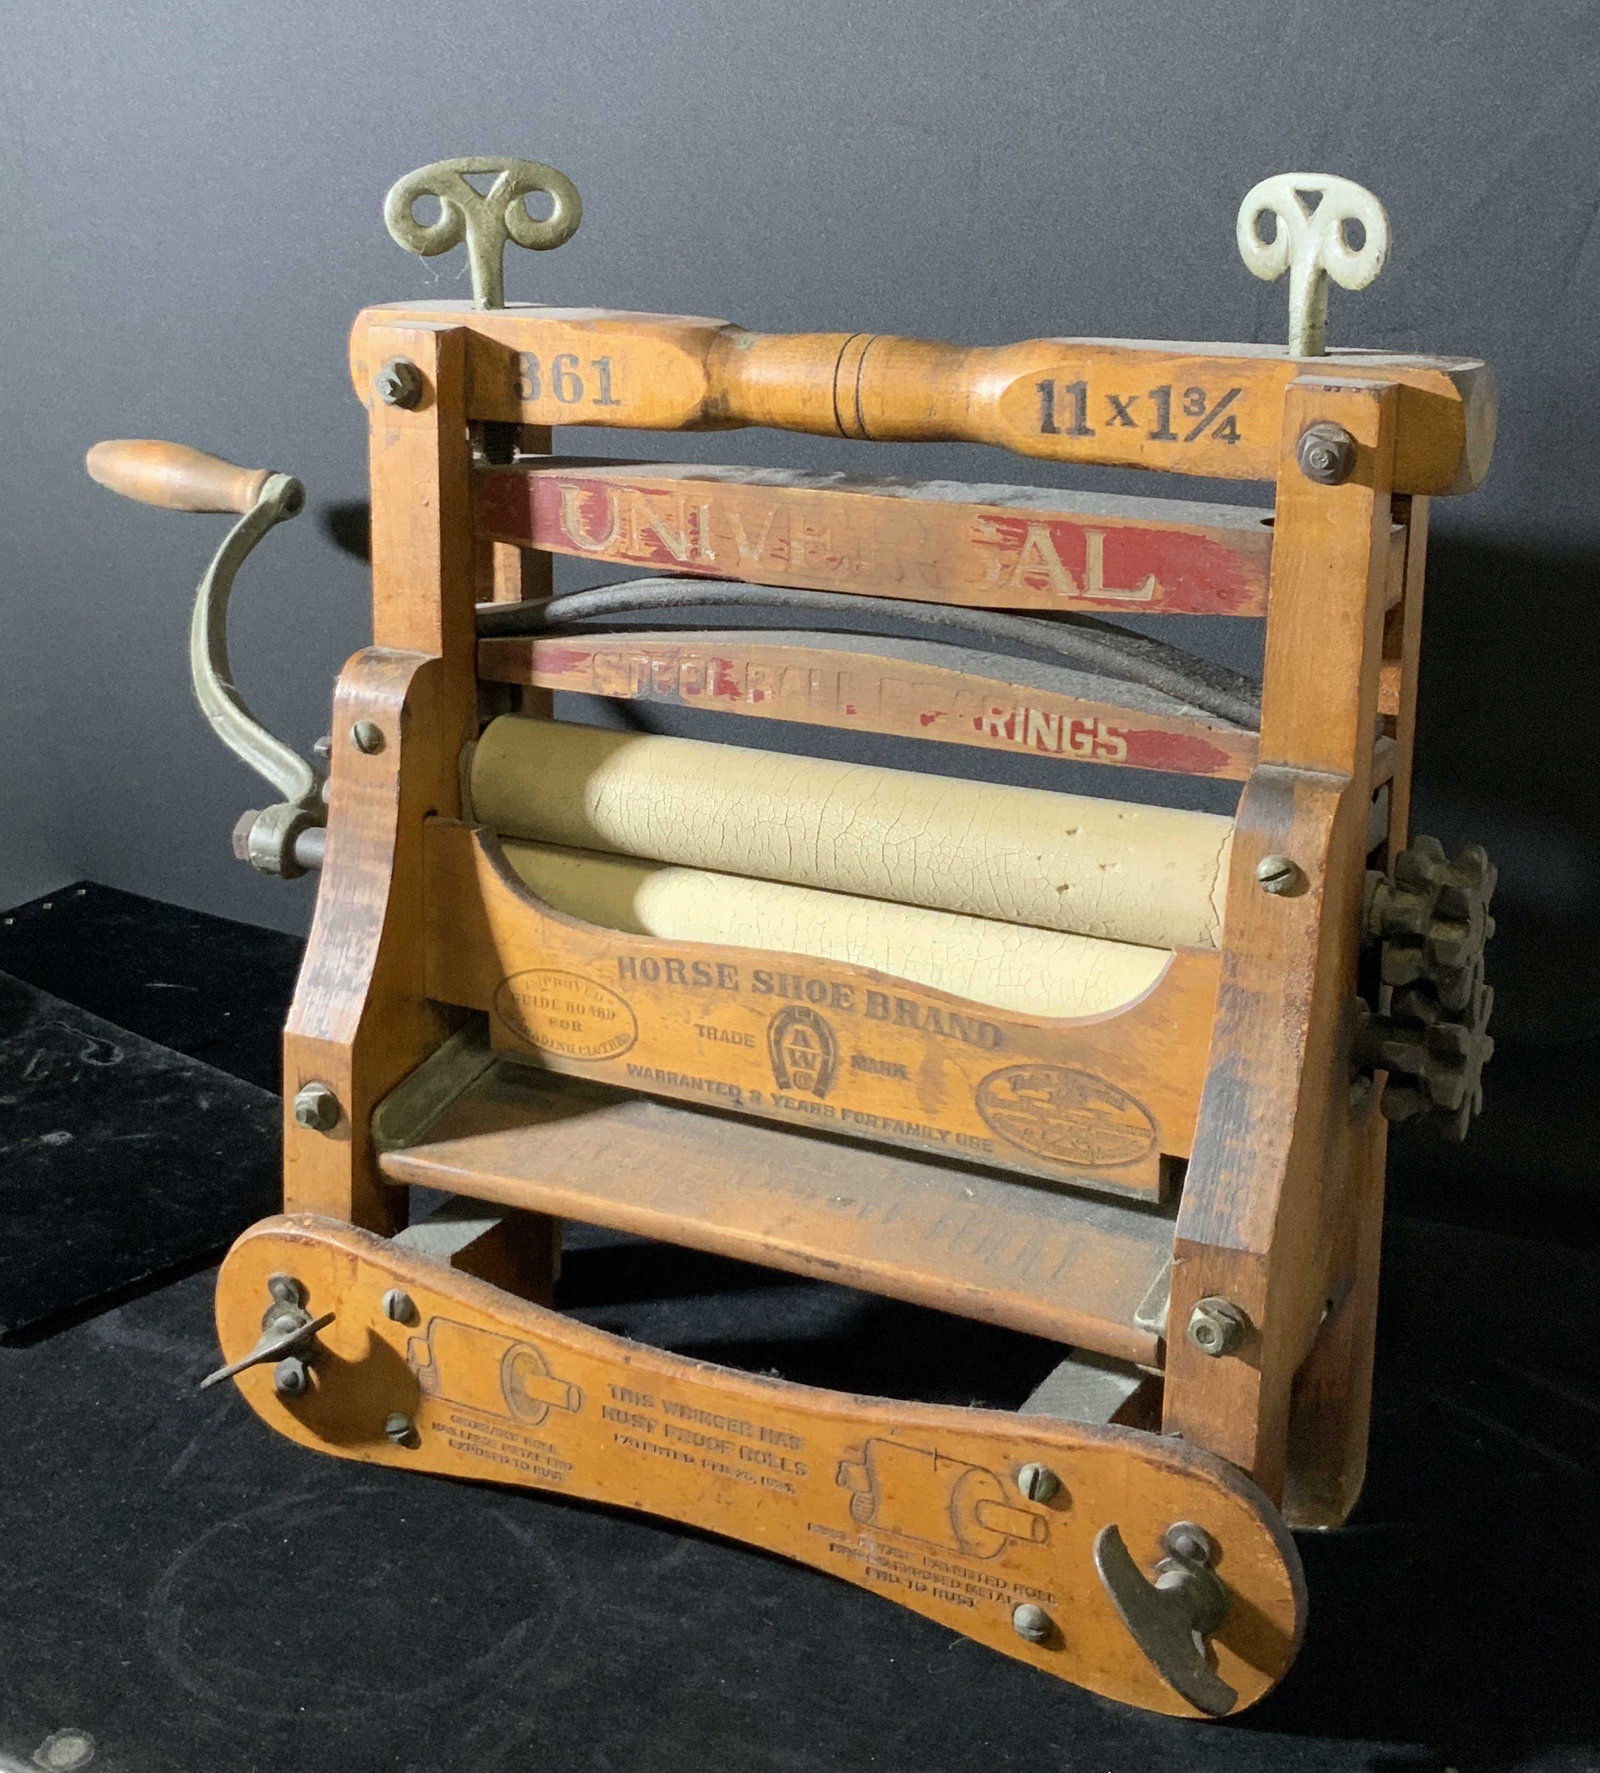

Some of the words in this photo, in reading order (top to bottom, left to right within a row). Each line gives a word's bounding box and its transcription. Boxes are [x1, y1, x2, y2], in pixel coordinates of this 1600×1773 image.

[559, 484, 1156, 601] UNIVESAL
[566, 1000, 617, 1022] BOARD
[616, 956, 739, 992] HORSE
[752, 969, 855, 1012] SHOE
[864, 990, 1004, 1050] BRAND
[548, 1017, 583, 1033] FOR
[695, 1024, 759, 1049] TRADE
[790, 1029, 811, 1047] A
[851, 1054, 910, 1080] MARK
[626, 1063, 742, 1098] WARRANTED
[769, 1092, 837, 1118] YEARS
[841, 1109, 878, 1129] FOR
[881, 1116, 952, 1145] FAMILY
[955, 1134, 994, 1153] USE
[609, 1384, 655, 1408] THIS
[662, 1399, 753, 1436] WRINGER
[513, 1459, 530, 1471] TO
[740, 1445, 808, 1476] ROLLS
